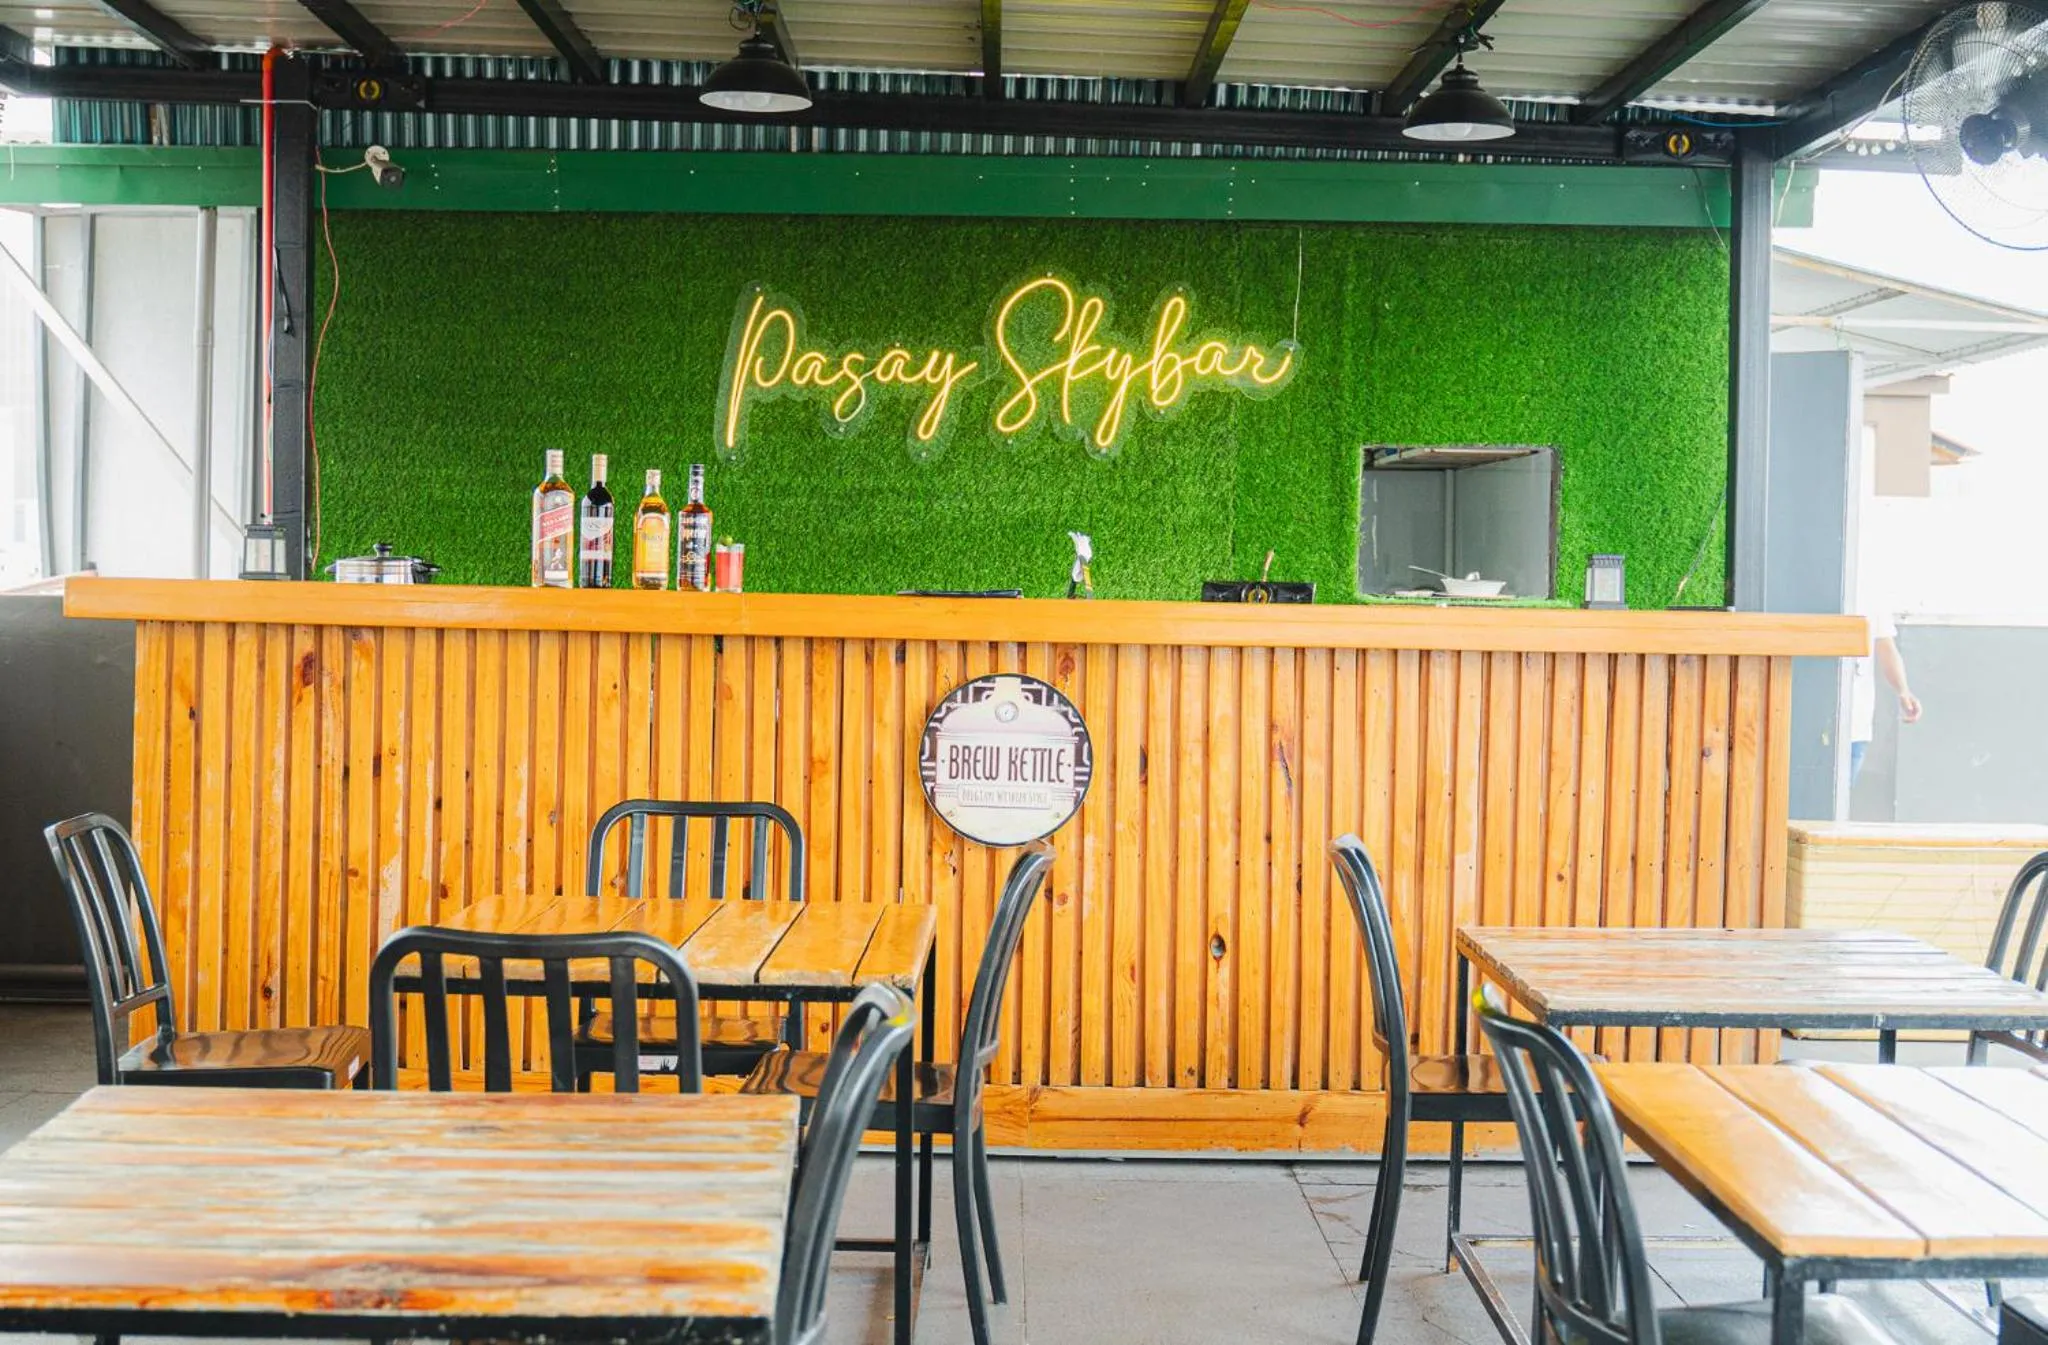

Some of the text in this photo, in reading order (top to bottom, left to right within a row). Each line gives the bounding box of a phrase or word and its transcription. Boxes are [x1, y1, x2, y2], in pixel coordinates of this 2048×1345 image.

[725, 277, 1294, 448] Pasay Skybar
[949, 744, 1066, 783] BREW KETTLE
